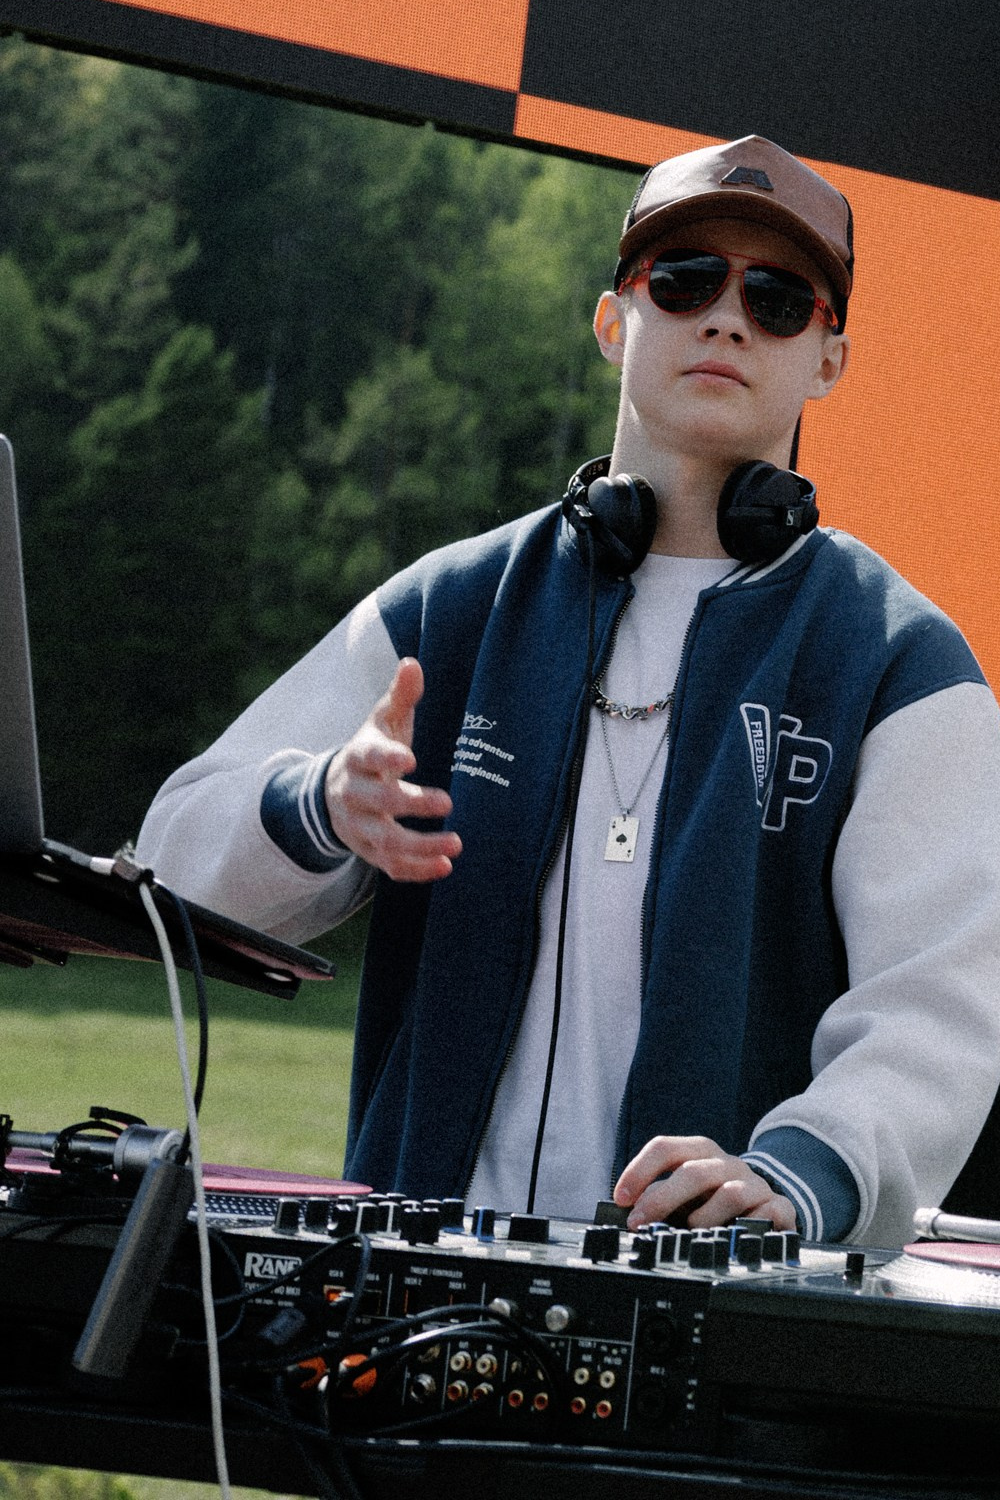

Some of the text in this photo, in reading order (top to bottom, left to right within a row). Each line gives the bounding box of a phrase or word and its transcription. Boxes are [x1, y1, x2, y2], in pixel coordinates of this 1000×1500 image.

[468, 738, 515, 762] adventure
[750, 720, 766, 788] FREEDOM
[459, 762, 511, 788] imagination
